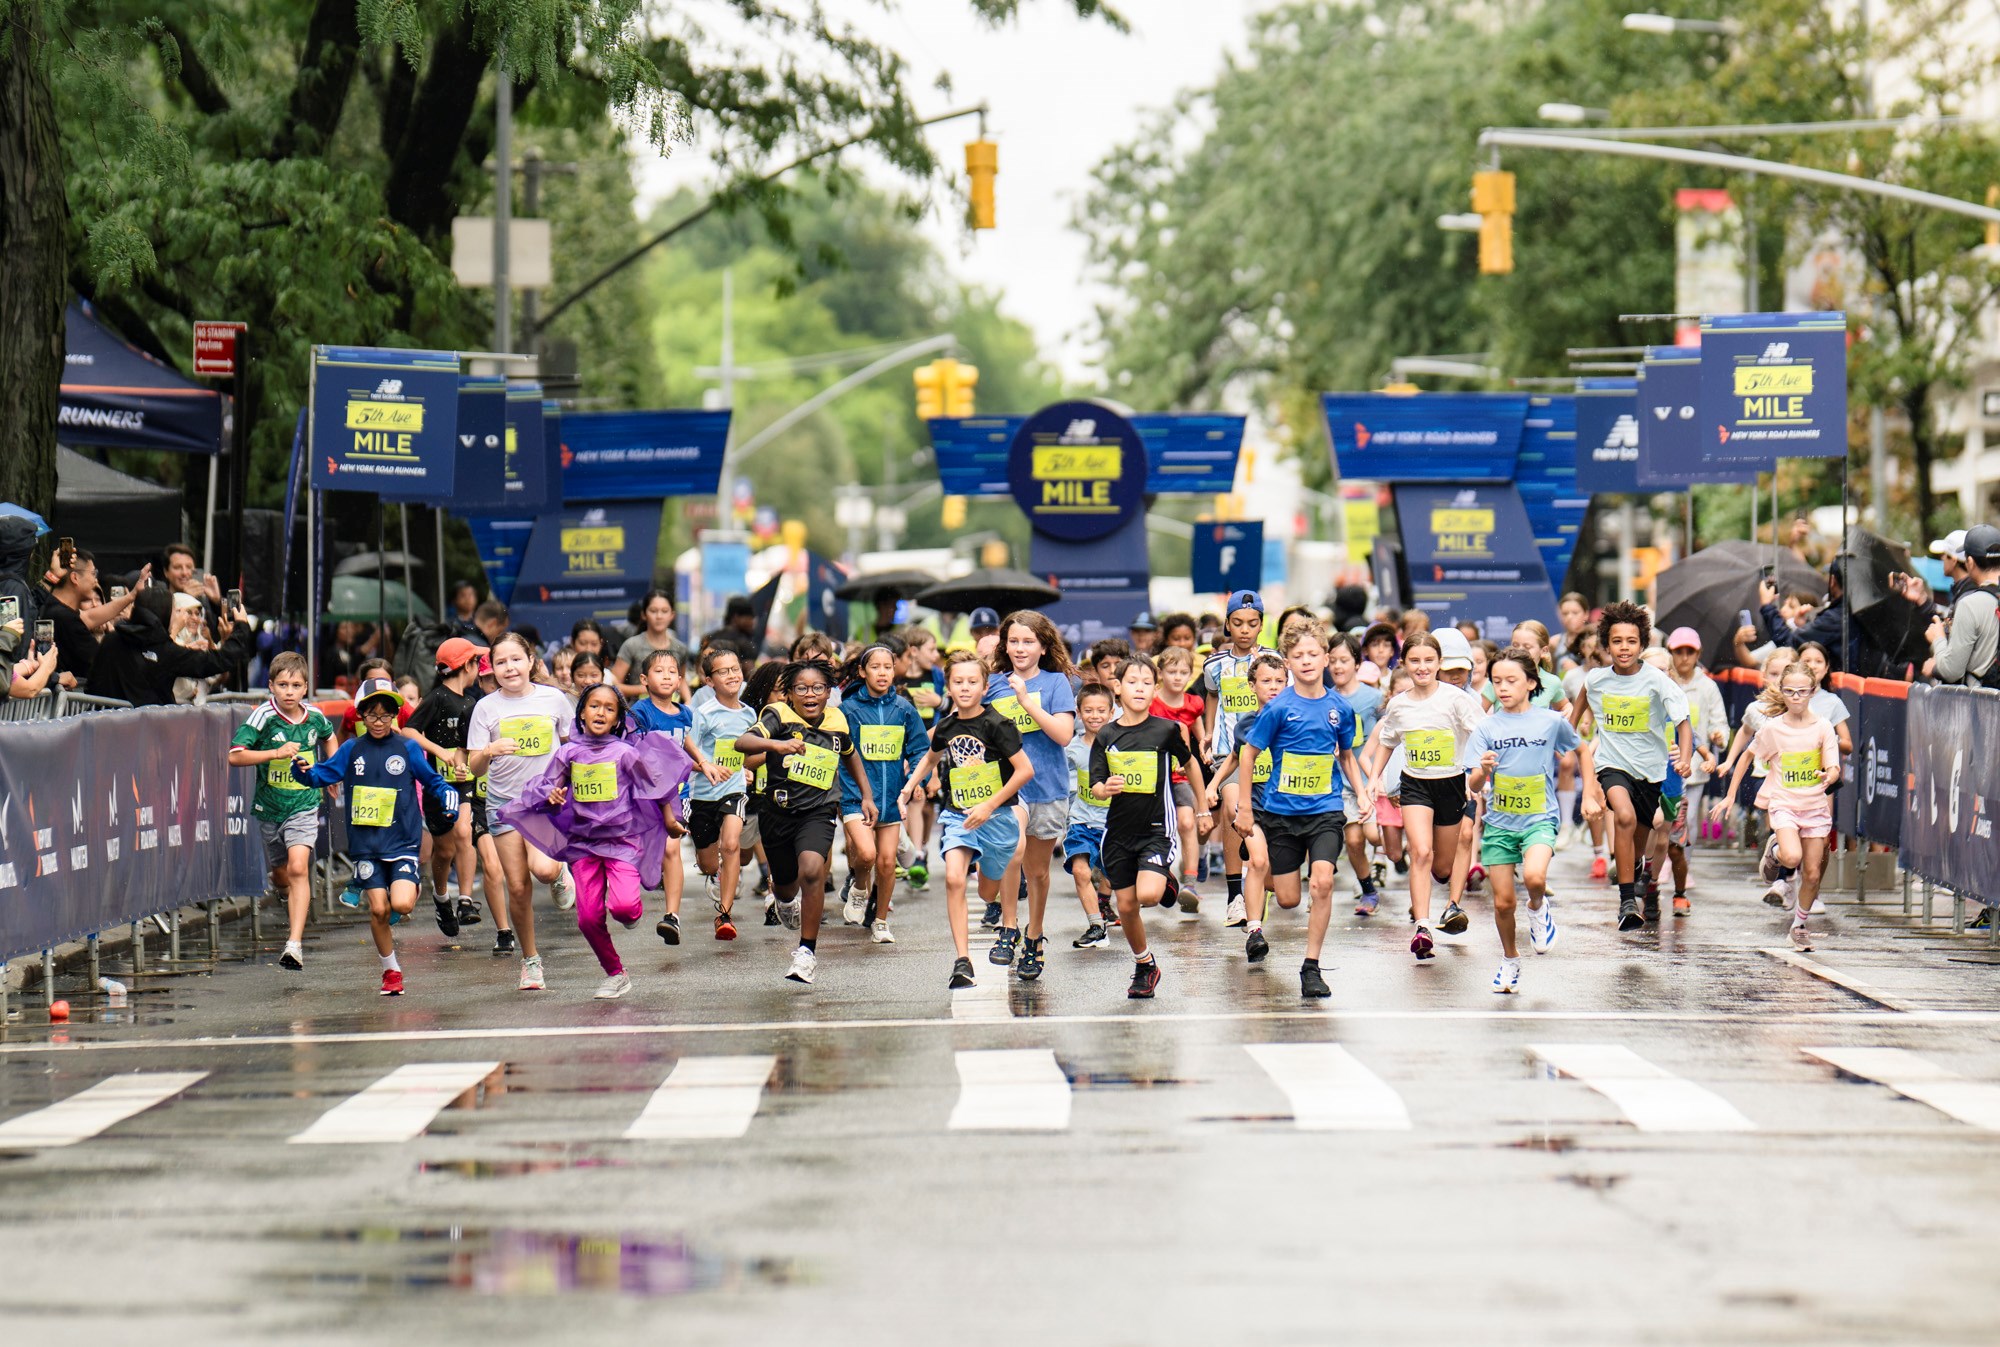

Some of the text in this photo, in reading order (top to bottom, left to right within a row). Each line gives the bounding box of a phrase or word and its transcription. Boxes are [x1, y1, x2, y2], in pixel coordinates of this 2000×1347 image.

[197, 327, 206, 338] NO
[197, 340, 223, 352] Anytime
[1744, 372, 1803, 390] 5th Ave
[1744, 396, 1804, 418] MILE
[58, 405, 144, 431] RUNNERS
[355, 408, 412, 424] 5th Ave
[1730, 429, 1821, 440] NEW YORK ROAD RUNNERS
[354, 431, 412, 454] MILE
[339, 463, 427, 477] NEW YORK ROAD RUNNERS
[1042, 480, 1110, 504] MILE
[1438, 532, 1487, 551] MILE
[569, 551, 617, 570] MILE
[1494, 737, 1528, 750] USTA
[271, 770, 294, 783] YH16
[355, 764, 365, 776] 12
[1509, 796, 1531, 809] 733
